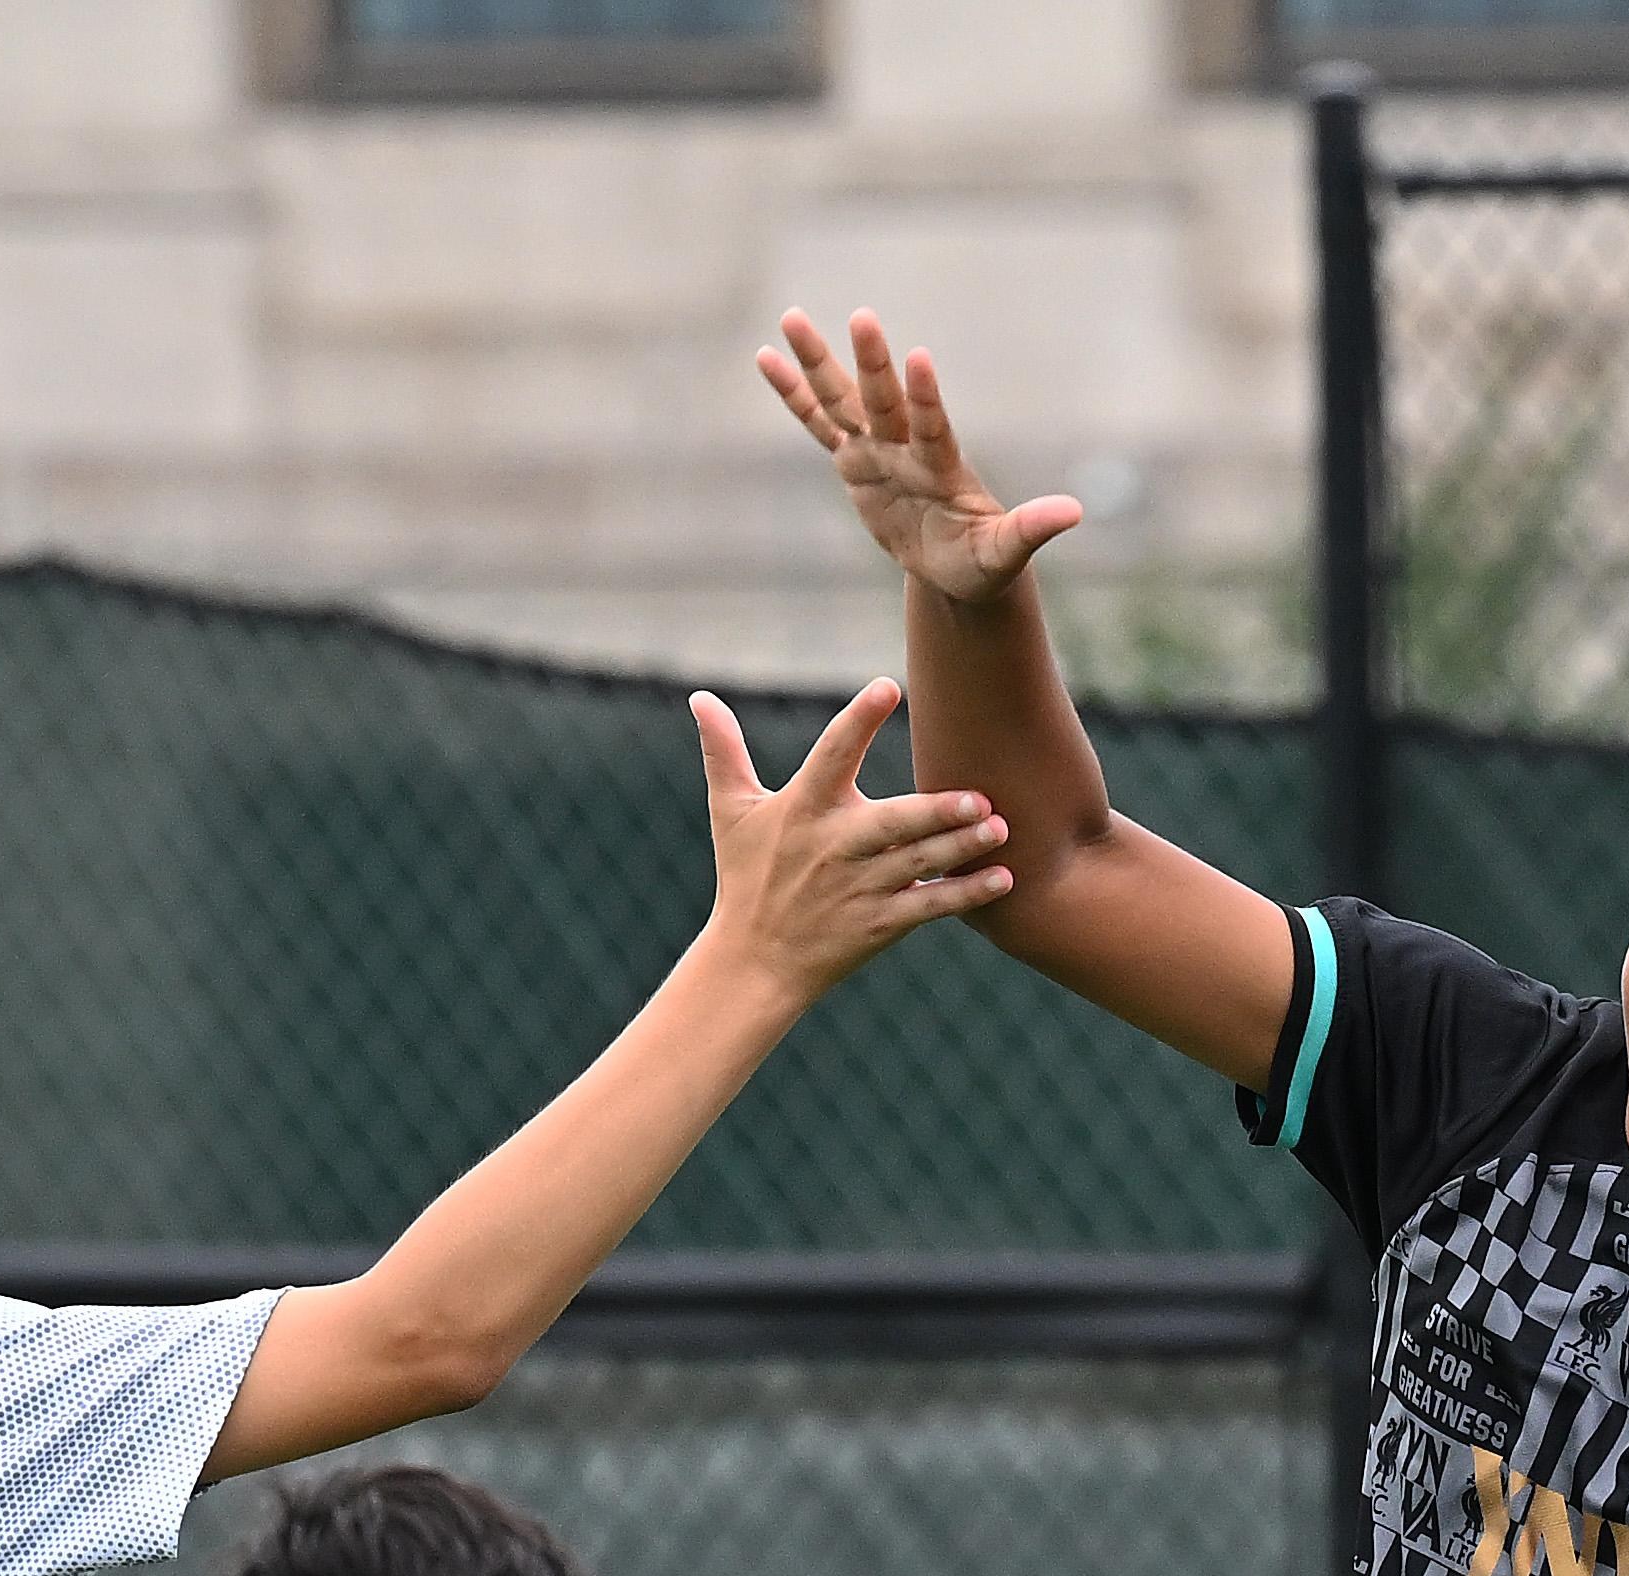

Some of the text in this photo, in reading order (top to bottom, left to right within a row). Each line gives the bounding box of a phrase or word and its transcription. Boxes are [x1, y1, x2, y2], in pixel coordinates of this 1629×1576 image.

[1425, 1302, 1494, 1366] STRIVE
[1427, 1345, 1473, 1392] FOR
[1398, 1363, 1509, 1450] GREATNESS
